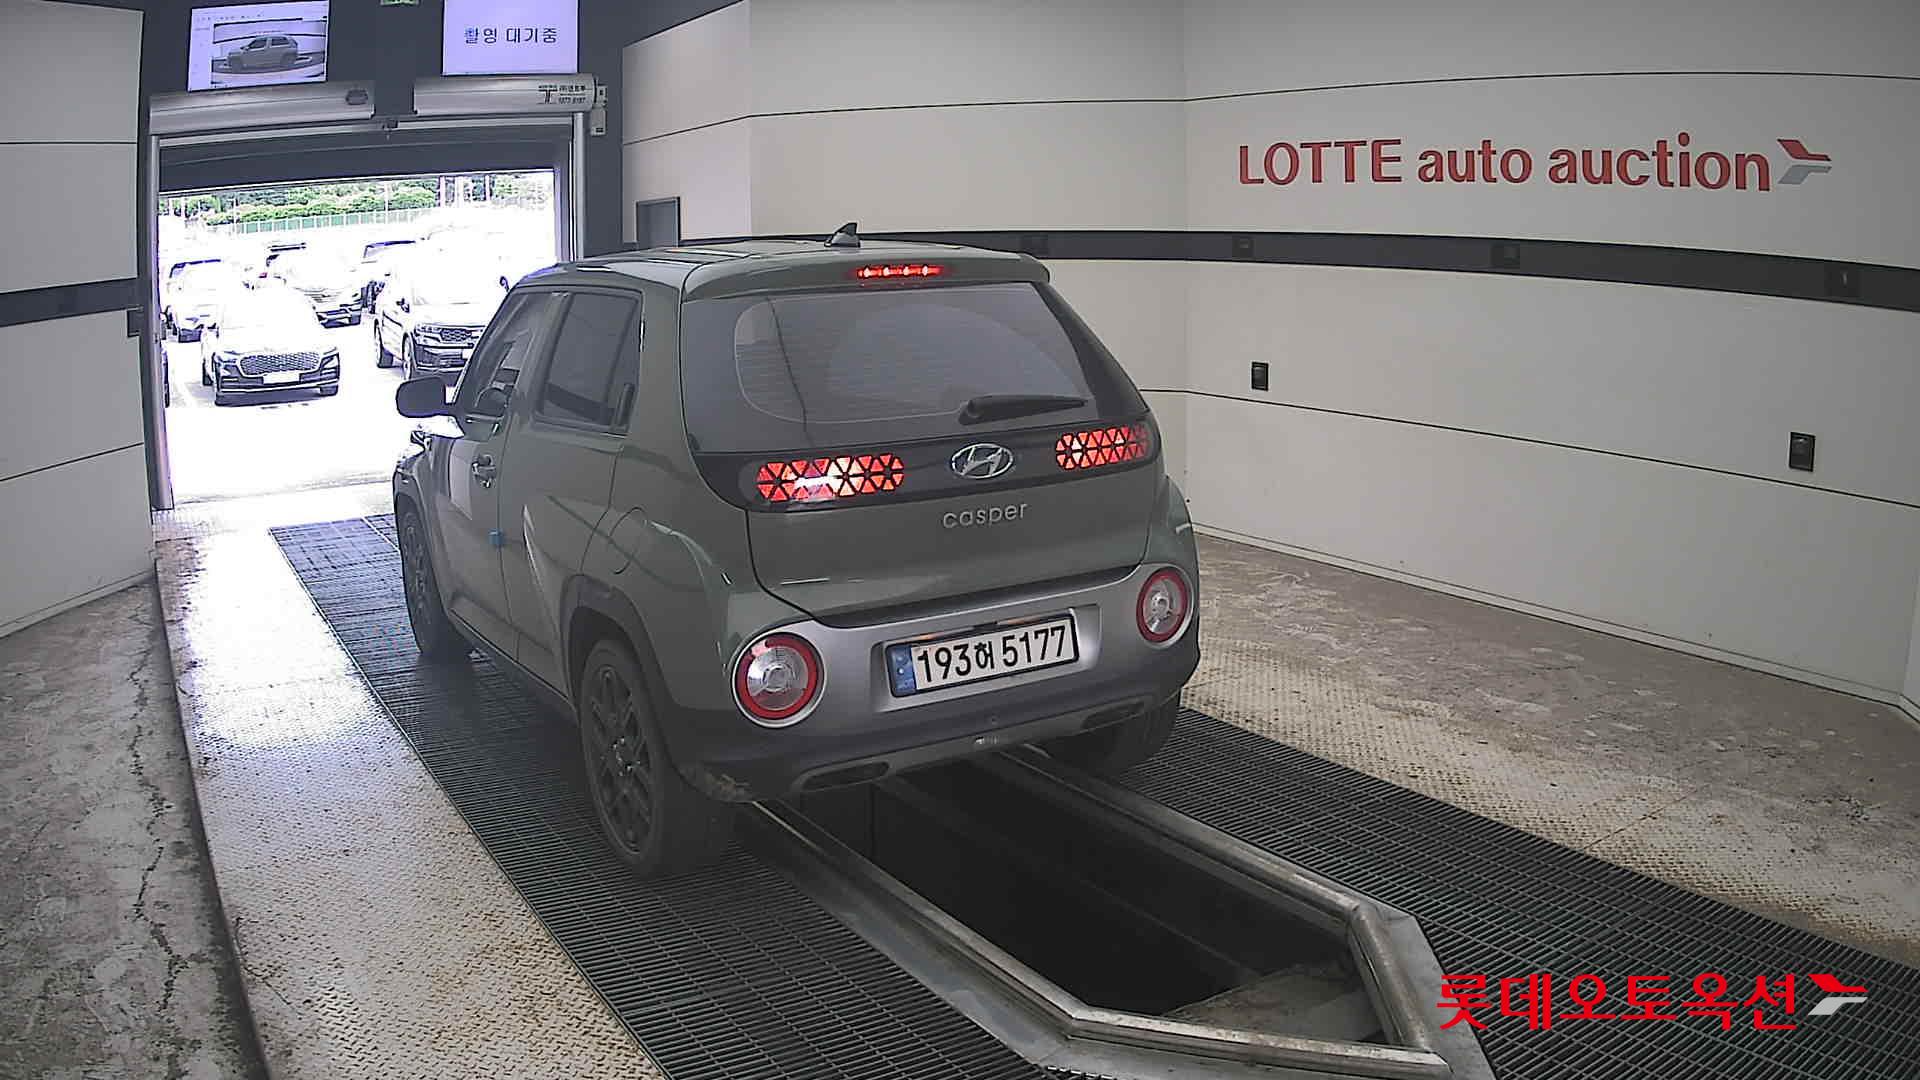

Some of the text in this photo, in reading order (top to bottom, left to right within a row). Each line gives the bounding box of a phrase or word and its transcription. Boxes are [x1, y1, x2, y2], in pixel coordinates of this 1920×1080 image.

[505, 27, 557, 43] 대기중
[1239, 132, 1771, 191] LOTTE auto auction
[943, 503, 1028, 528] casper
[1001, 625, 1066, 667] 5177
